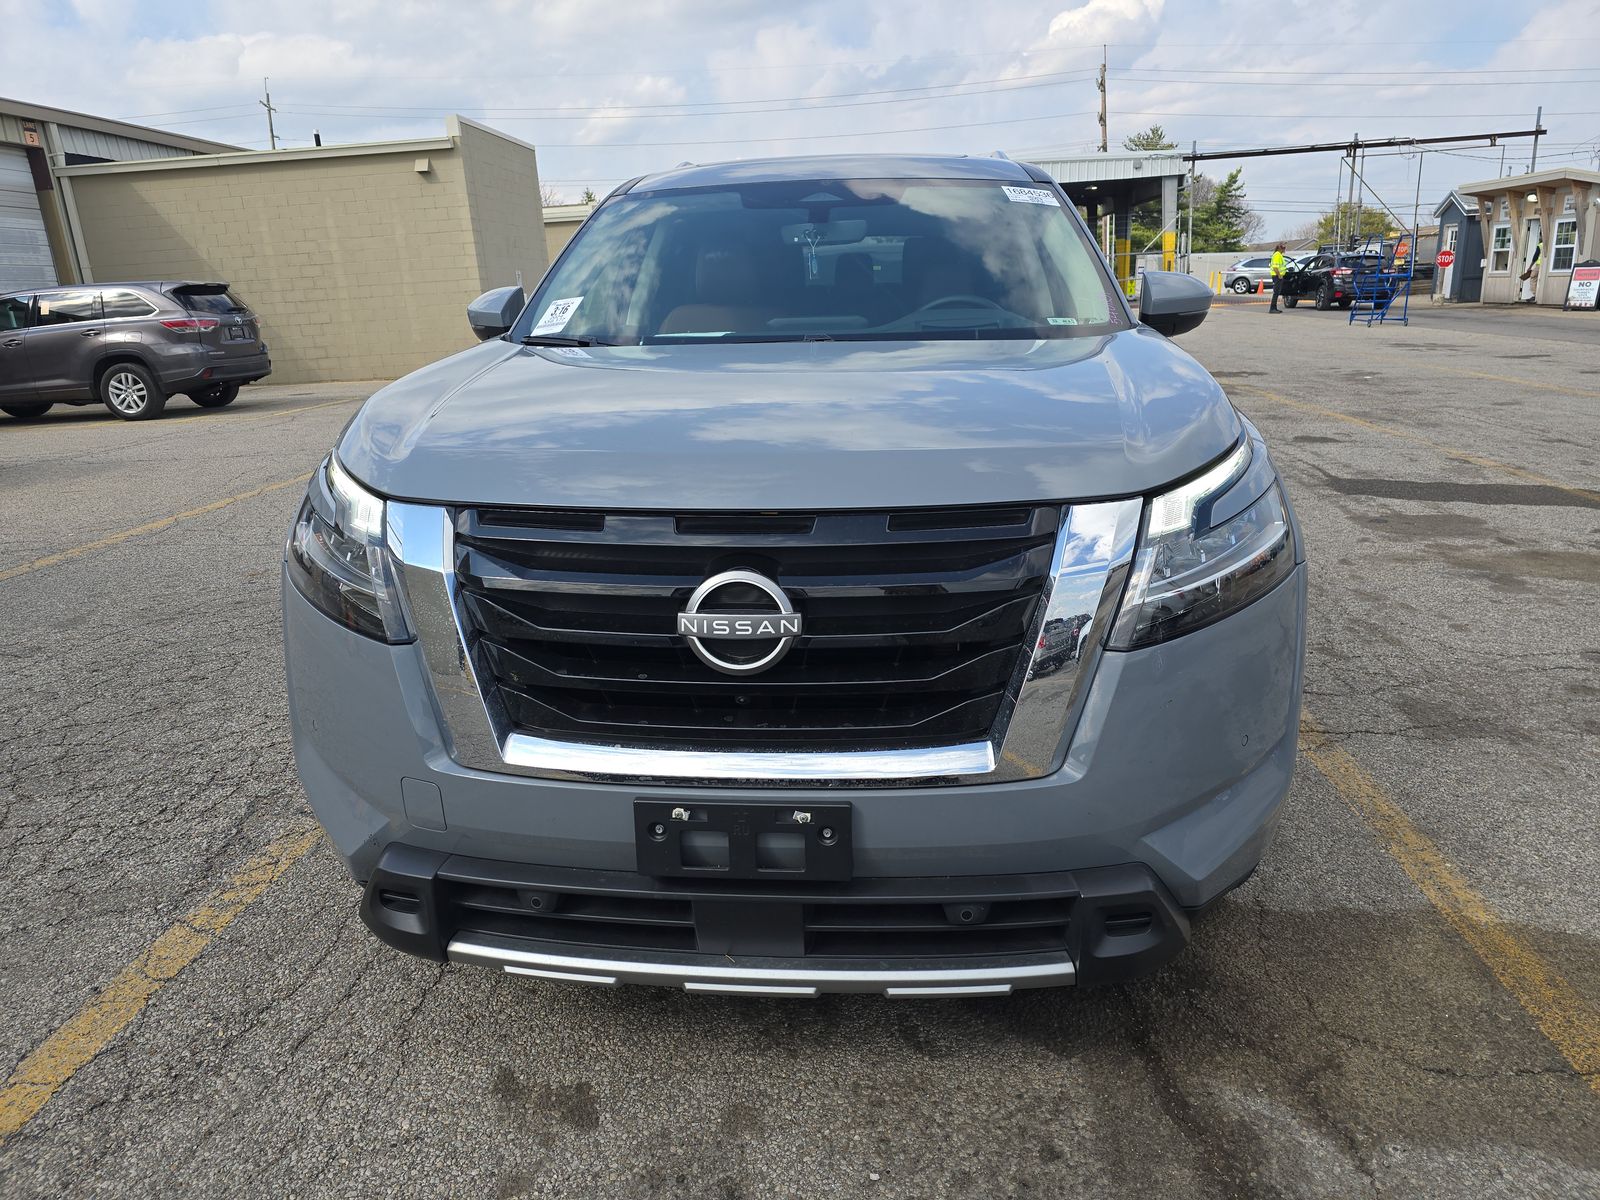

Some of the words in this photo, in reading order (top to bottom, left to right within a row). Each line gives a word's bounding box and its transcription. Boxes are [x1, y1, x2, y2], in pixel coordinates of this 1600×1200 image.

[29, 133, 35, 143] 5
[1437, 255, 1454, 263] STOP
[681, 618, 798, 635] NISSAN
